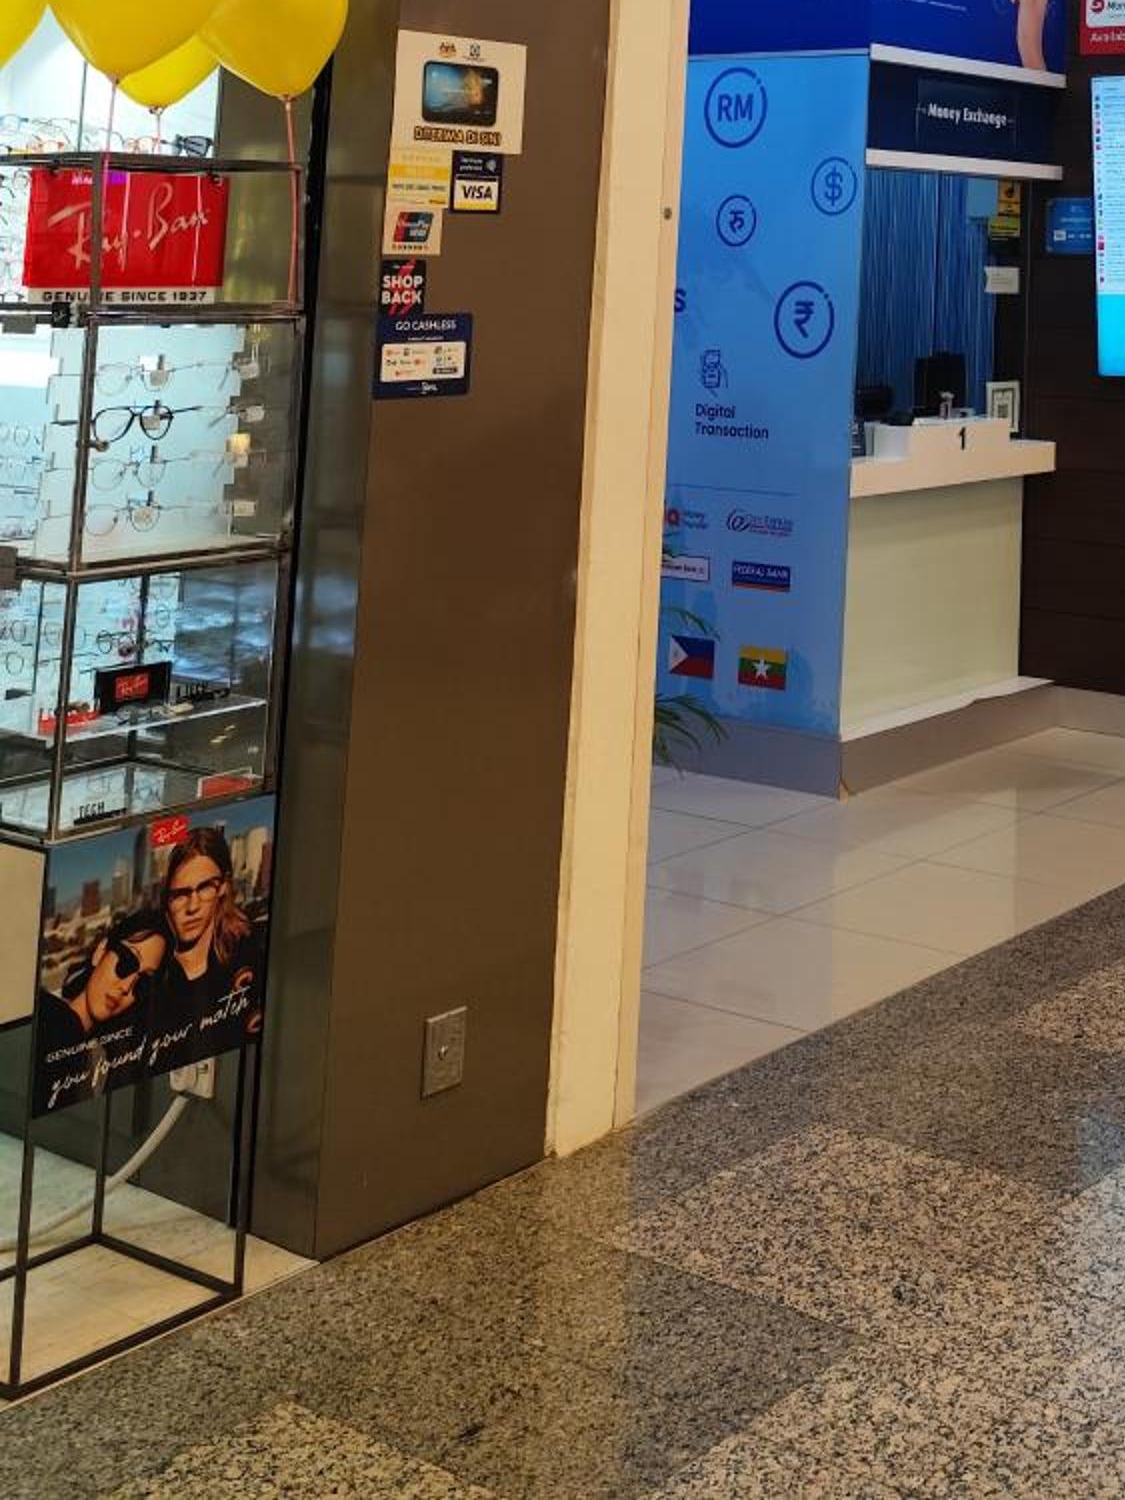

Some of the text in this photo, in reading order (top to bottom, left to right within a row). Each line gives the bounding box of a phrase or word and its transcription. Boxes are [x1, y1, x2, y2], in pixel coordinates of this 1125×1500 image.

[717, 93, 754, 122] RM
[928, 103, 1007, 128] Money Exchange
[462, 185, 493, 199] VISA
[383, 275, 423, 288] SHOP
[42, 291, 207, 302] GENUE SINCE 1937
[381, 291, 422, 304] BACK
[396, 319, 456, 331] GO CASHLESS
[695, 404, 735, 421] Digital
[695, 422, 769, 439] Transaction
[958, 427, 966, 450] 1
[46, 1026, 132, 1064] GENUINE SINCE
[91, 1035, 147, 1088] found
[149, 1022, 193, 1067] your
[200, 985, 251, 1031] match
